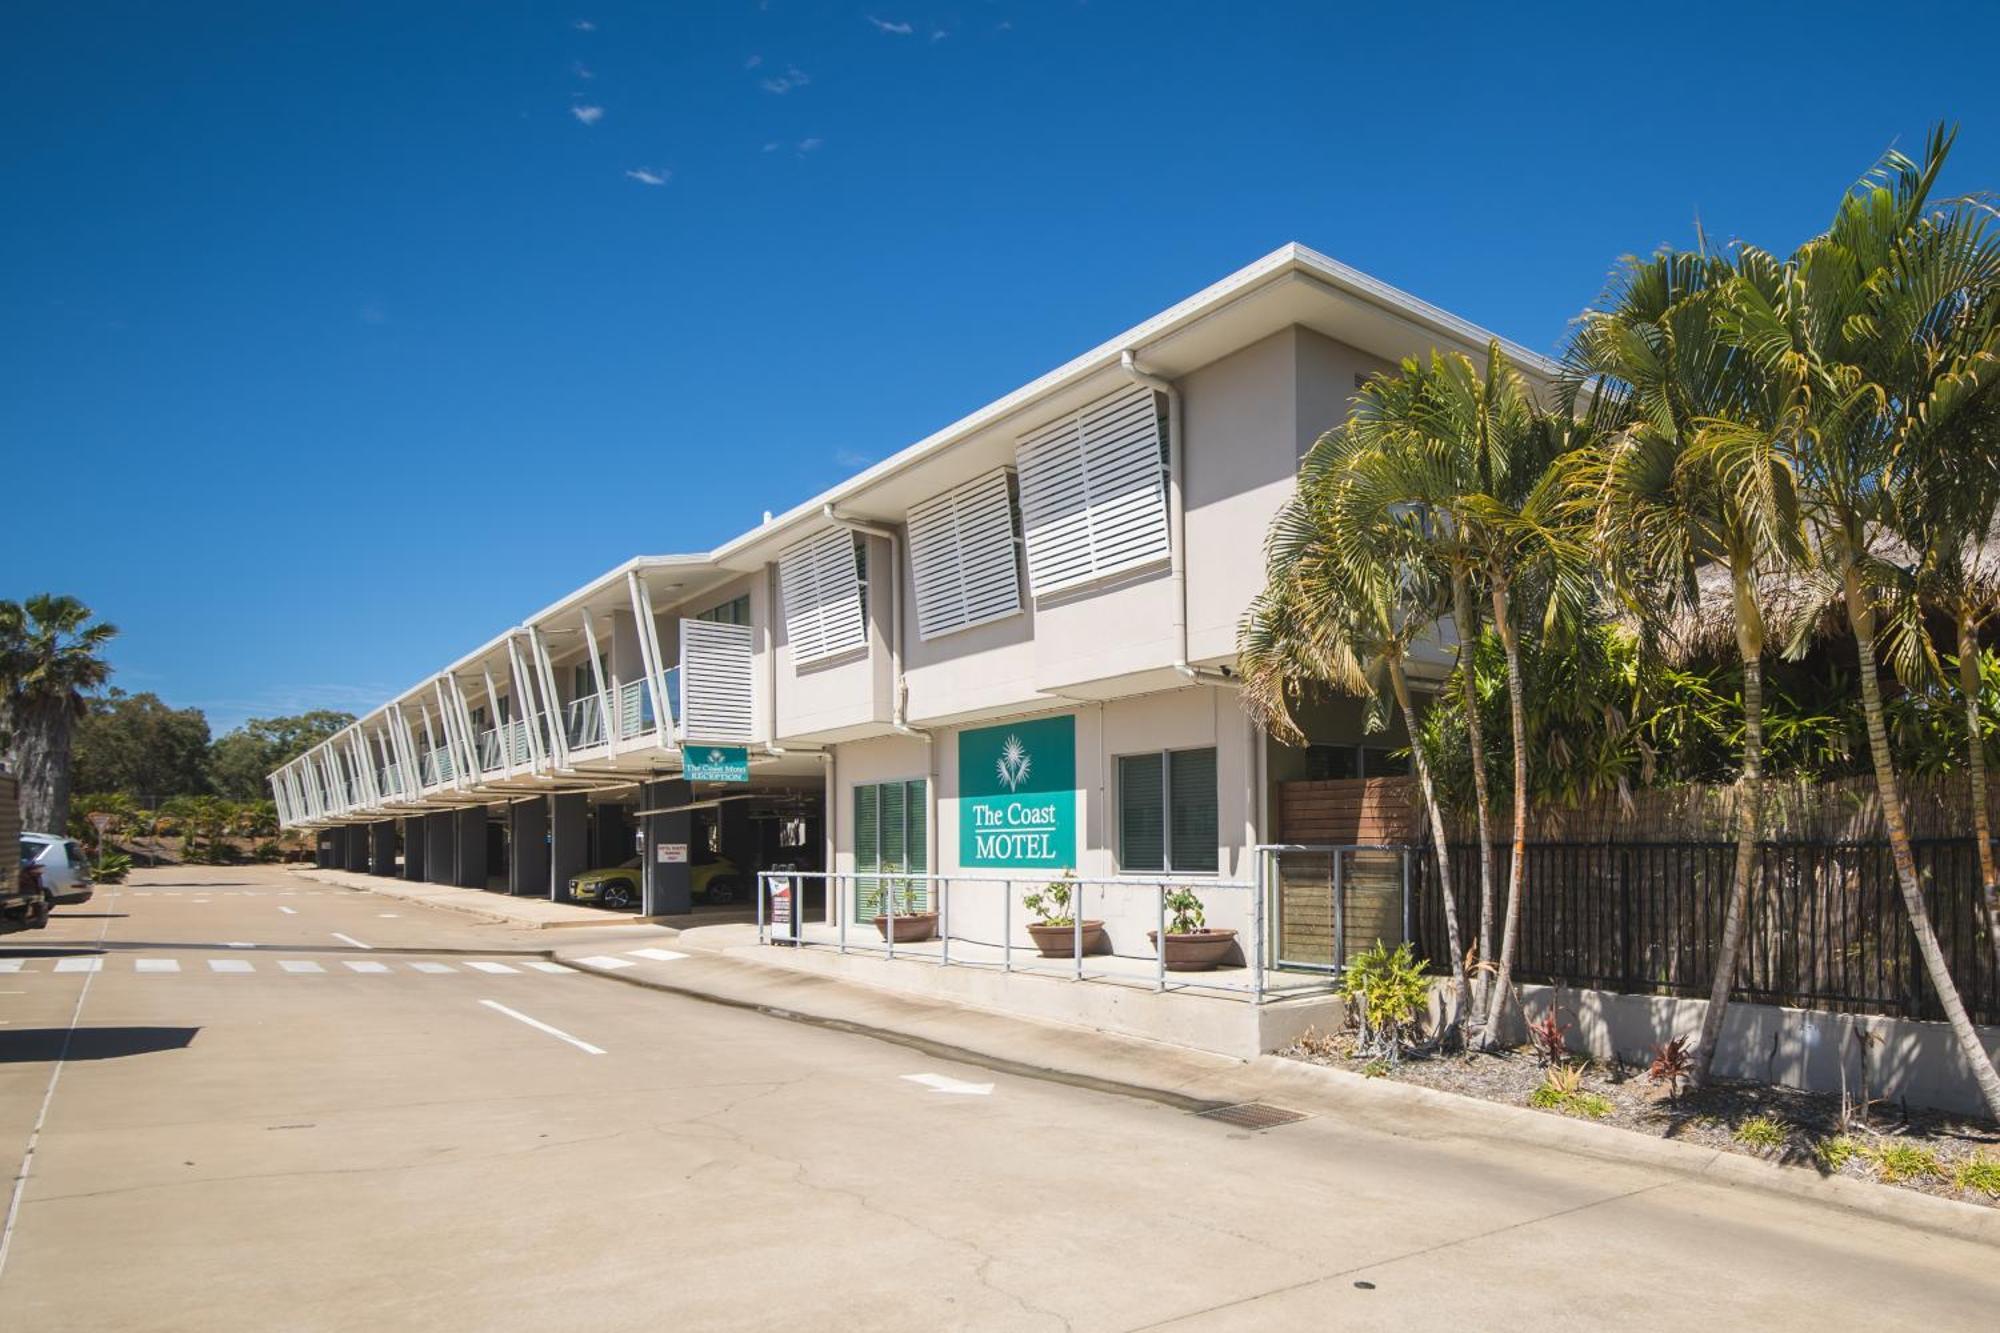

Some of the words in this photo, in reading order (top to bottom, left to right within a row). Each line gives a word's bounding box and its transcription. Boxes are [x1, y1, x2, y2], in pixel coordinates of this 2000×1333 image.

[687, 764, 701, 772] The
[973, 804, 1002, 826] The
[1007, 802, 1056, 825] Coast
[975, 834, 1056, 859] MOTEL
